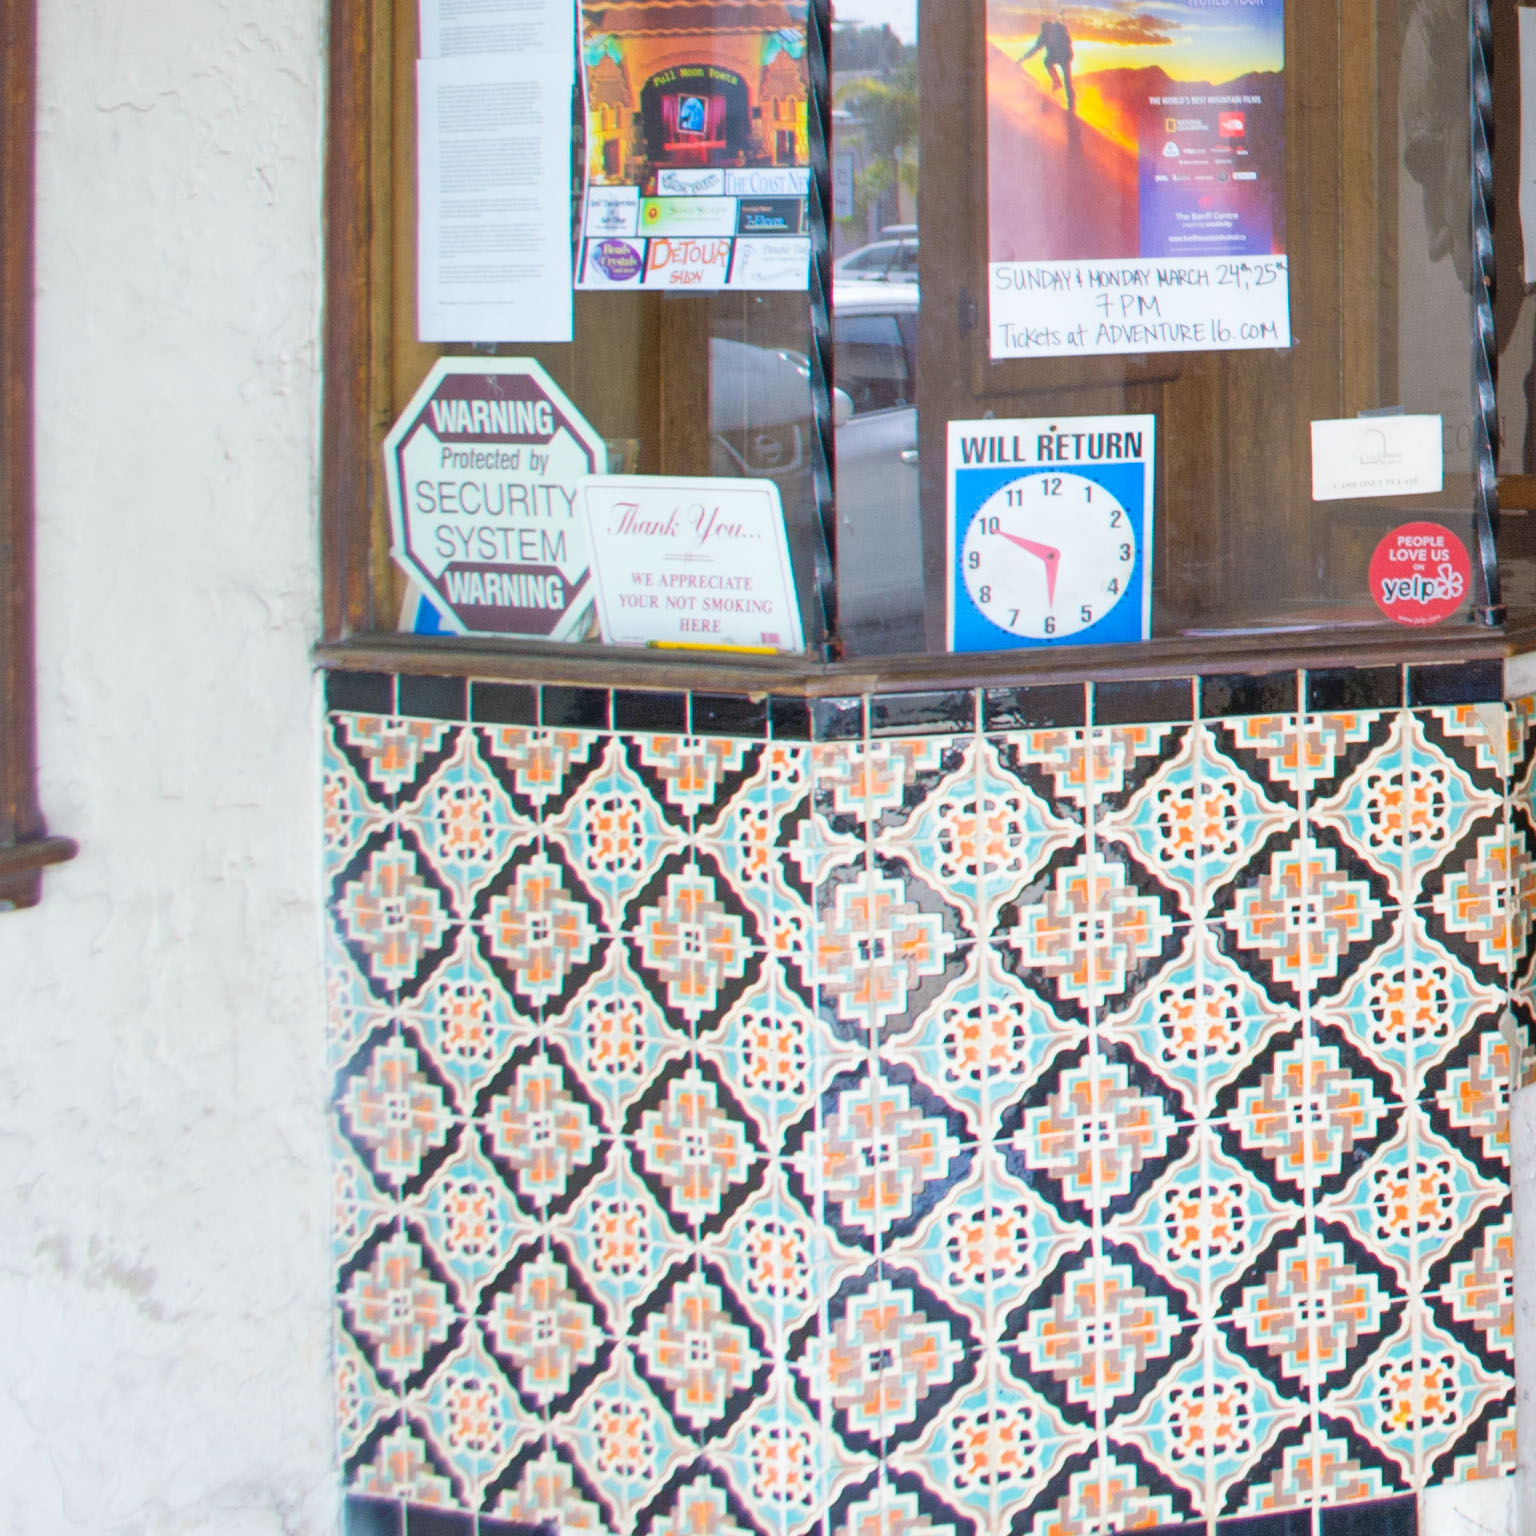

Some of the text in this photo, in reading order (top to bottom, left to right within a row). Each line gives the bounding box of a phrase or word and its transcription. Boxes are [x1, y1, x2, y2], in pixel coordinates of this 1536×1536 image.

[679, 67, 705, 78] Moon
[750, 171, 785, 192] COAST
[995, 266, 1071, 291] SUNDAY
[1089, 268, 1152, 288] MONDAY
[1156, 266, 1209, 287] MARCH
[1096, 292, 1162, 318] 7 PM
[998, 322, 1062, 348] Tickets
[1066, 326, 1089, 346] at
[430, 399, 555, 436] WARNING
[960, 431, 1143, 464] WILL RETURN
[440, 446, 549, 475] Protected by
[1042, 477, 1063, 496] 12
[1084, 485, 1093, 504] 1
[415, 480, 578, 518] SECURITY
[1006, 489, 1024, 507] 11
[607, 501, 681, 538] Thank
[979, 516, 1001, 535] 10
[1110, 510, 1121, 529] 2
[435, 524, 568, 563] SYSTEM
[1396, 535, 1445, 548] PEOPLE
[968, 551, 981, 570] 9
[1119, 543, 1132, 562] 3
[1388, 548, 1450, 562] LOVE US
[1412, 563, 1425, 571] ON
[444, 571, 566, 611] WARNING
[631, 572, 753, 591] WE APPRECIATE
[1107, 578, 1119, 595] 4
[1382, 575, 1436, 603] yelp
[618, 593, 774, 615] YOUR NOT SMOKING
[979, 585, 992, 604] 8
[1008, 609, 1021, 627] 7
[1080, 605, 1093, 623] 5
[679, 617, 722, 633] HERE
[1044, 616, 1056, 634] 6
